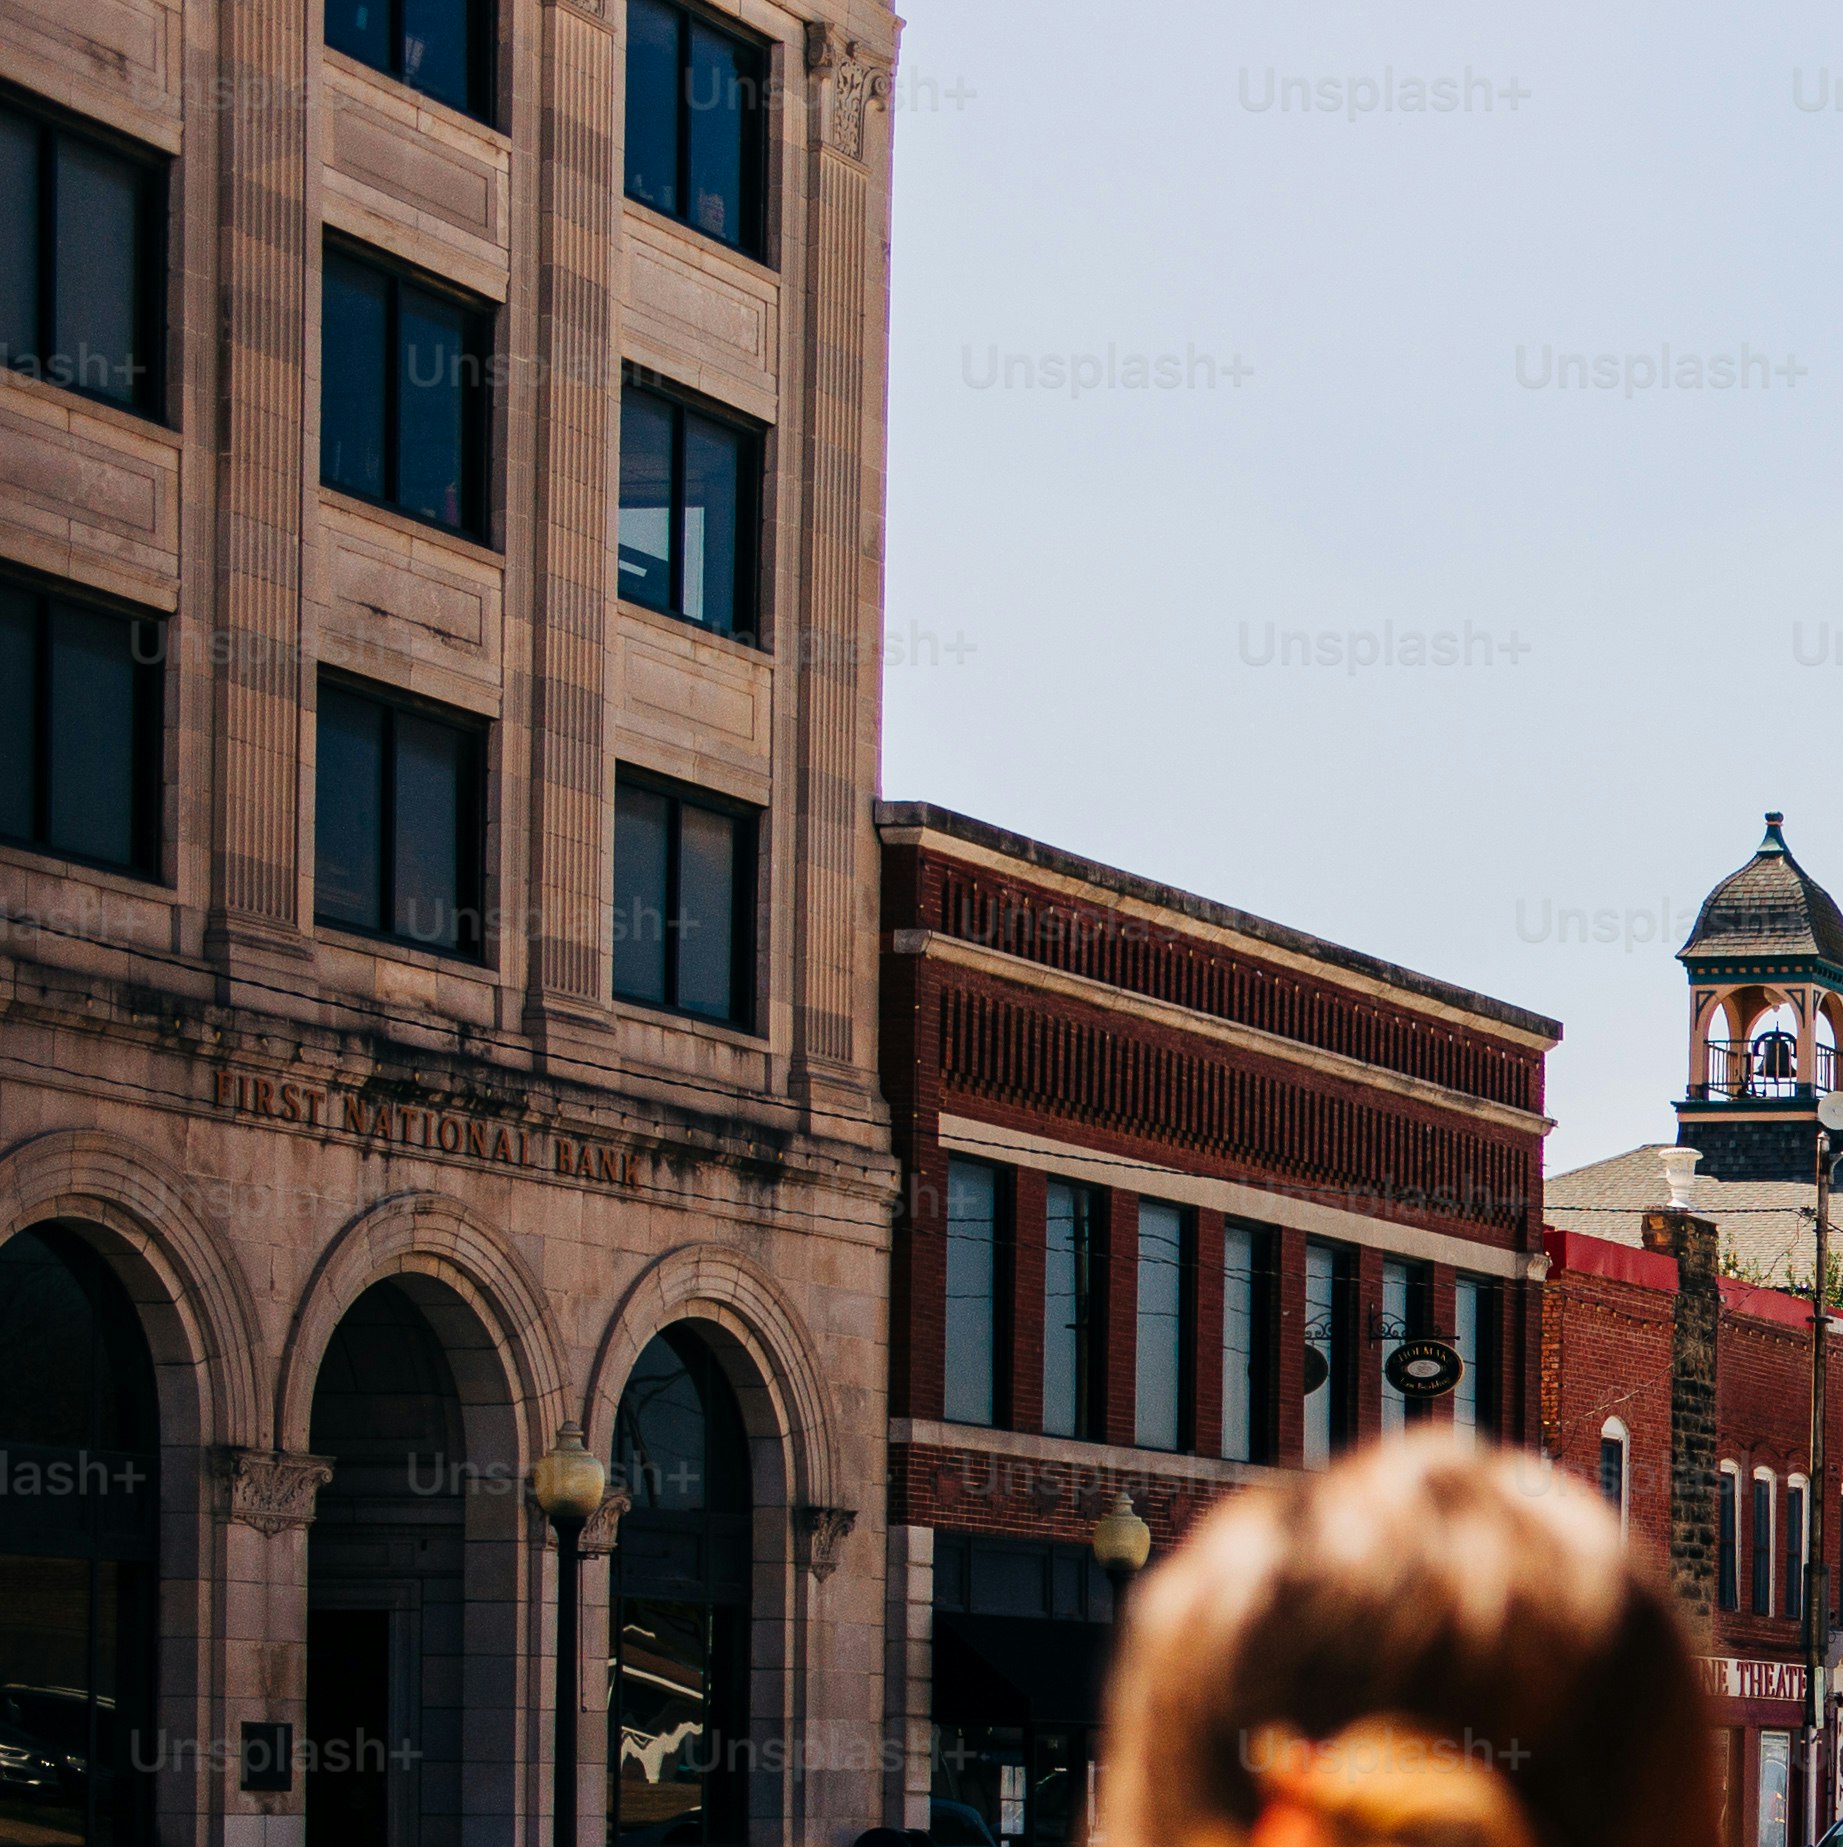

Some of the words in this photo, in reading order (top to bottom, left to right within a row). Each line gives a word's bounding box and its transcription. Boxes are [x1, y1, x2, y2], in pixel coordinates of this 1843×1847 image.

[215, 1070, 326, 1125] FIRST
[344, 1094, 534, 1170] NATIONAL
[555, 1137, 642, 1190] BANK
